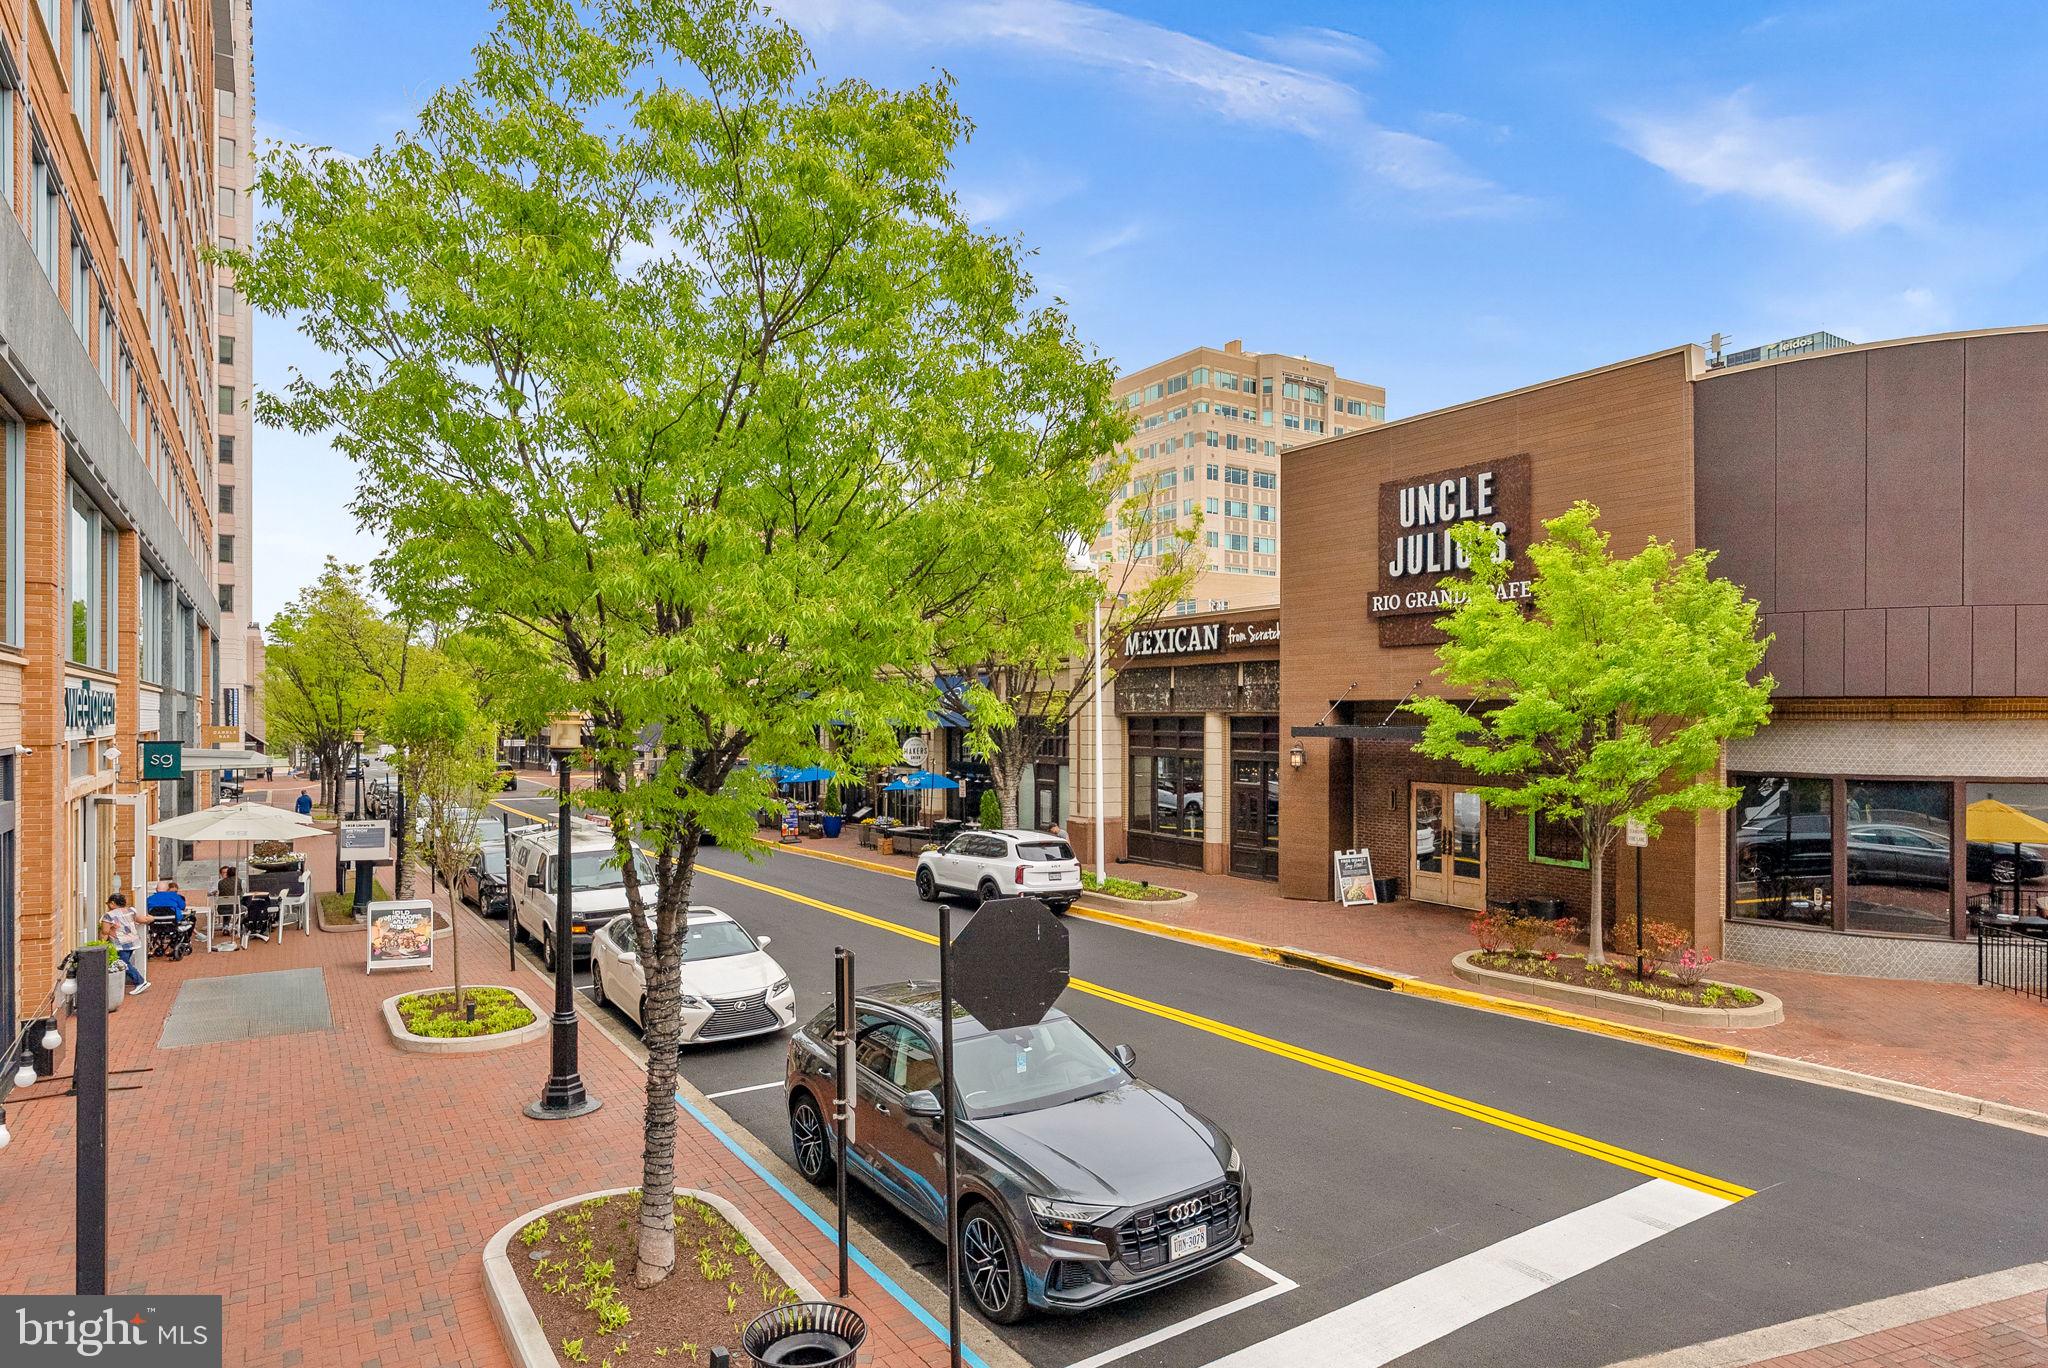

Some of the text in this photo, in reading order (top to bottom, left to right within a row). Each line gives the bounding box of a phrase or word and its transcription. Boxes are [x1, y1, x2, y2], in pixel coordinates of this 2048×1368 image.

[1780, 339, 1813, 352] leidos
[1400, 471, 1493, 528] UNCLE
[1372, 594, 1400, 612] RIO
[1488, 580, 1532, 601] AFE
[1124, 624, 1220, 657] MEXICAN
[1227, 626, 1247, 645] from
[150, 753, 174, 768] sg
